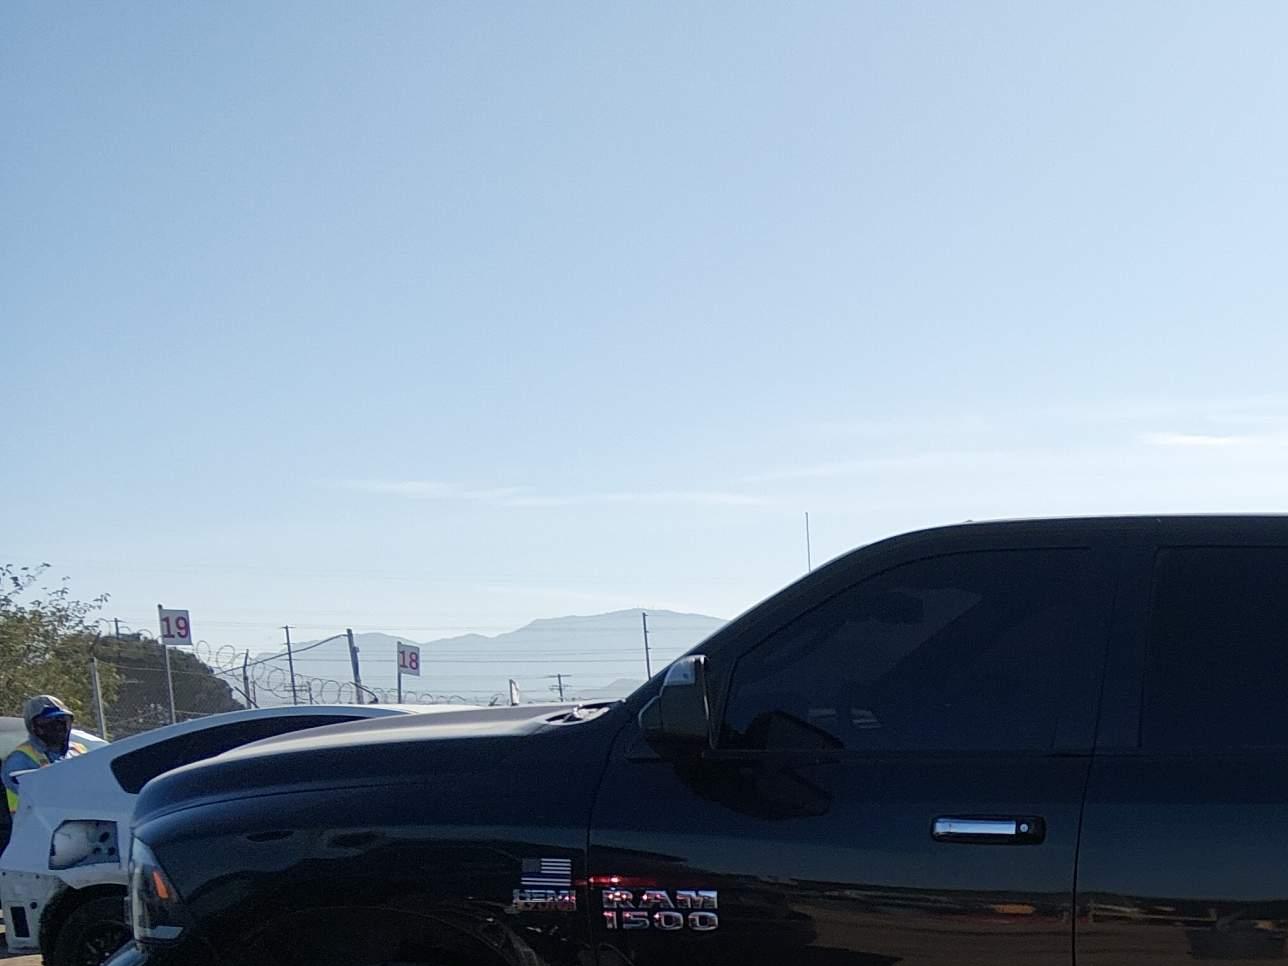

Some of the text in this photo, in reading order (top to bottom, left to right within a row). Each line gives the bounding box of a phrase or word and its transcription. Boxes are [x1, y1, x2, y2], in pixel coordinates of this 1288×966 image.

[161, 615, 190, 639] 19
[399, 650, 419, 670] 18
[601, 888, 721, 909] RAM
[602, 910, 721, 932] 1500
